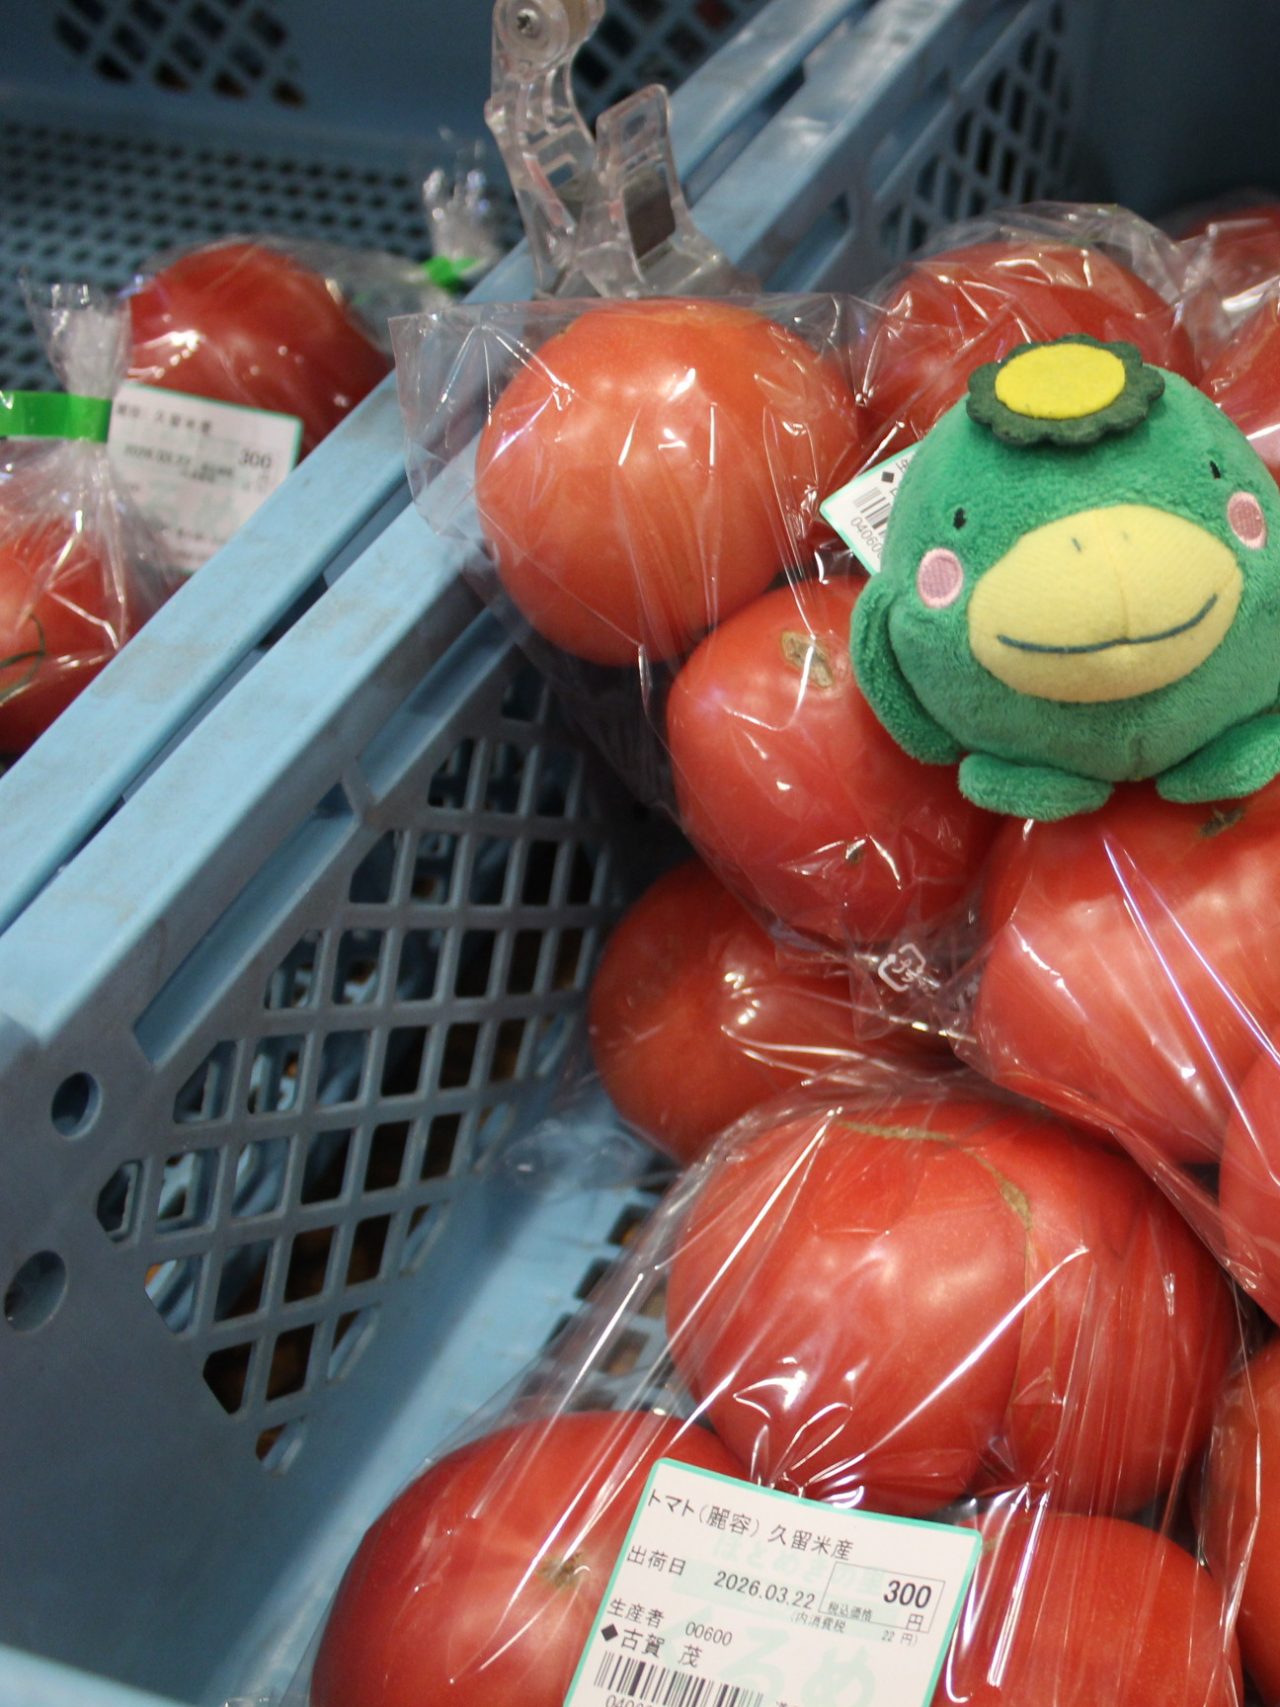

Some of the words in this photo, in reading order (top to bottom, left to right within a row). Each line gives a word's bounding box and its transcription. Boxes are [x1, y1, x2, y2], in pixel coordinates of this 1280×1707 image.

[238, 448, 273, 470] 300
[648, 1489, 760, 1540] トマト(麗容)
[768, 1525, 855, 1561] 久留米産
[627, 1545, 687, 1577] 出荷日
[713, 1570, 816, 1610] 2026.03.22
[883, 1580, 932, 1609] 300
[606, 1598, 665, 1629] 生産者
[685, 1621, 733, 1646] 00600
[828, 1602, 873, 1622] 税込価格
[906, 1613, 925, 1633] 円
[620, 1627, 666, 1659] 古賀
[677, 1643, 704, 1669] 茂
[881, 1630, 896, 1643] 22
